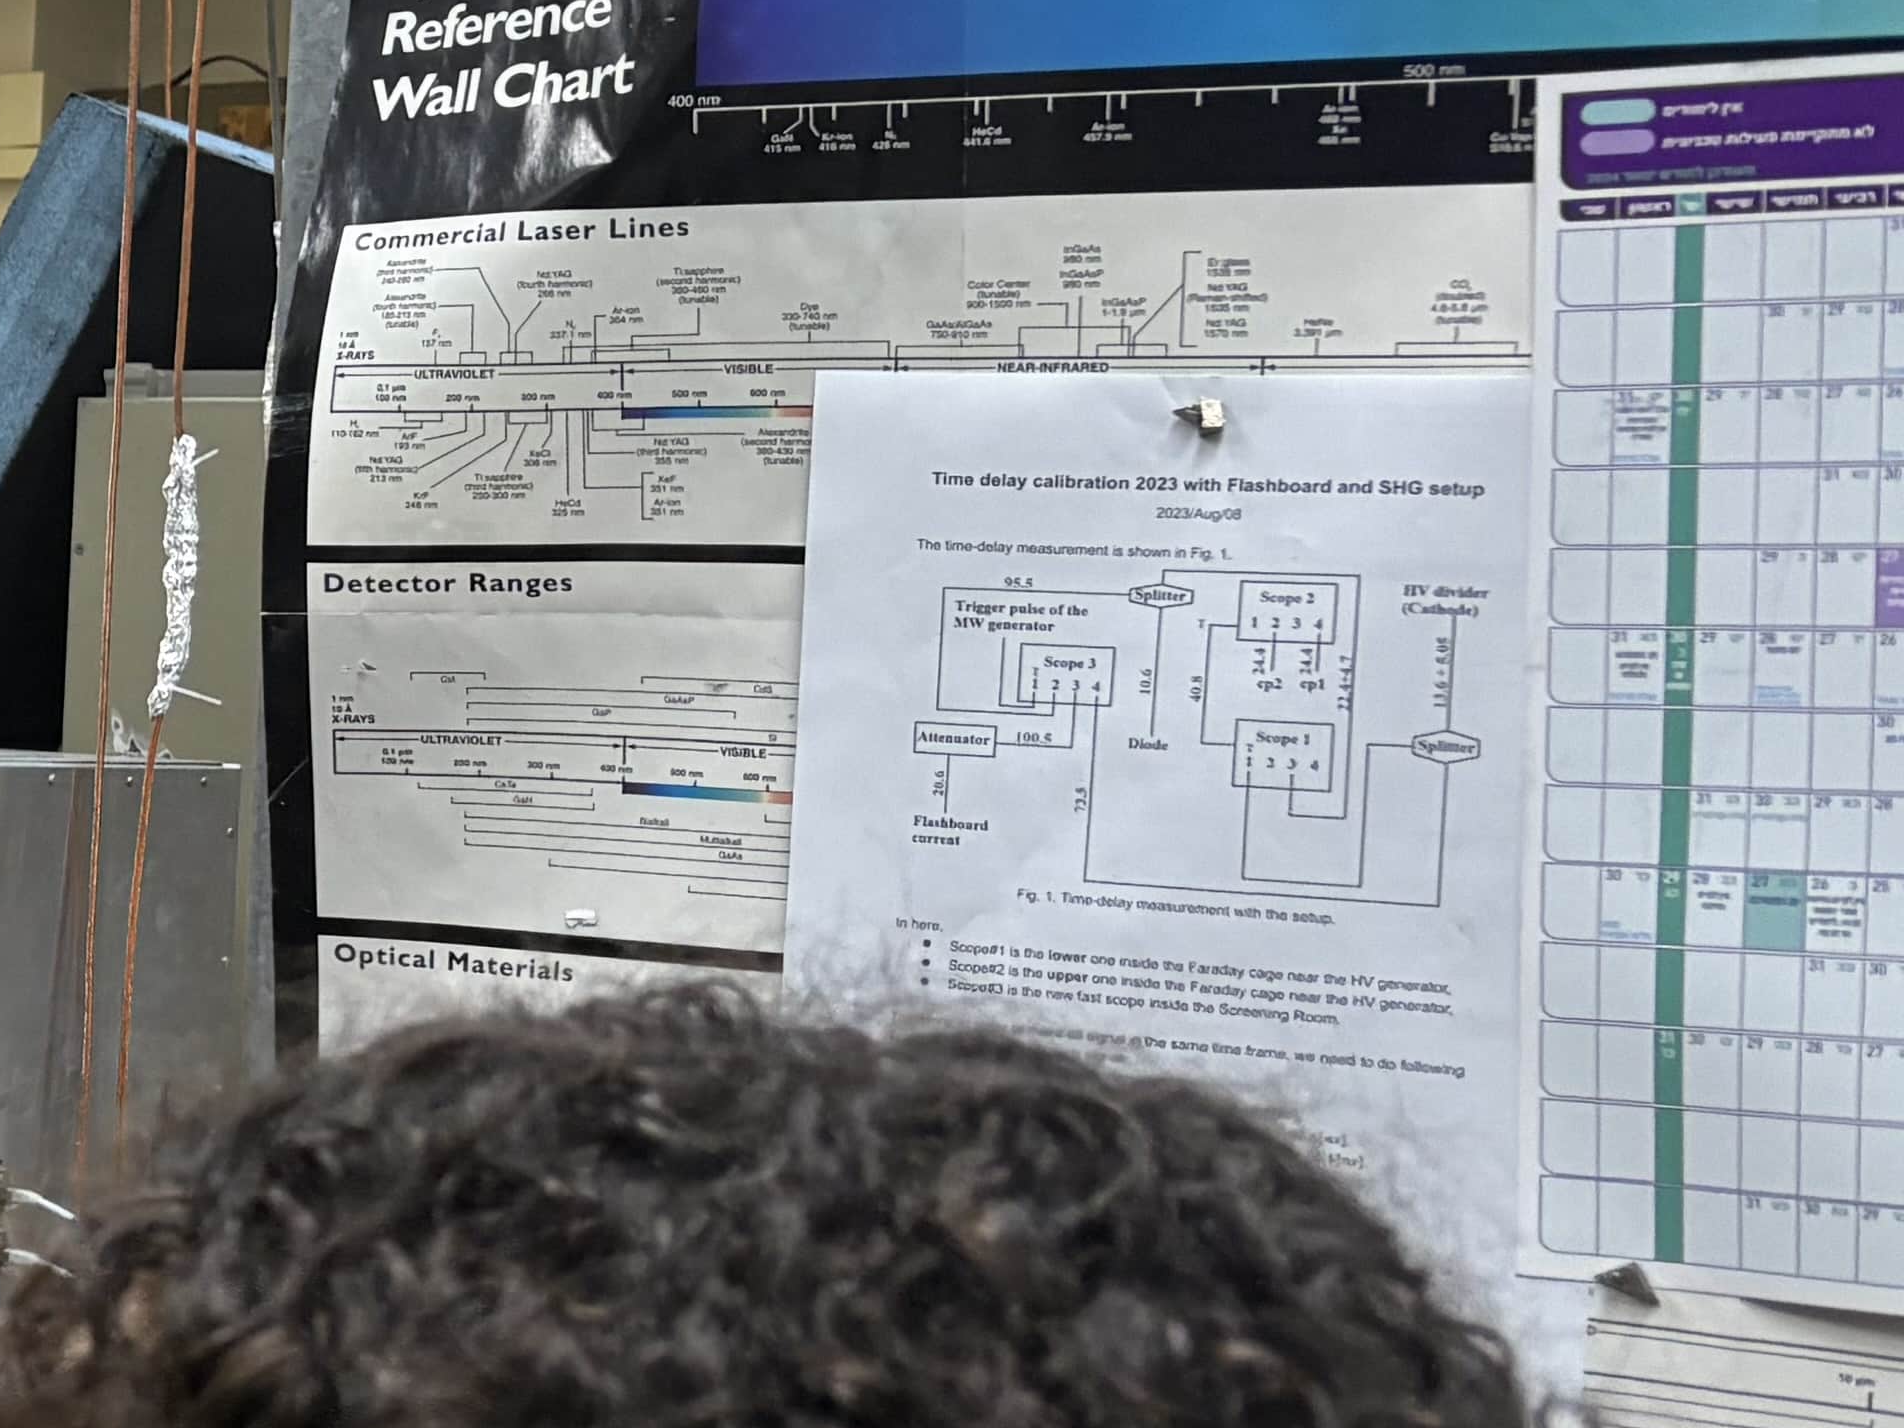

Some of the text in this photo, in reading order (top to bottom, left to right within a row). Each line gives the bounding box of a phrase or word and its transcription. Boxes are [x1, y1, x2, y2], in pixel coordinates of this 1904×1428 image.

[1403, 63, 1466, 78] 500 nm
[372, 53, 636, 122] Wall Chart
[667, 95, 722, 107] 400 nm
[355, 218, 690, 251] Commercial Laser Lines
[414, 369, 496, 380] ULTRAVIOLET
[723, 363, 774, 375] VISIBLE
[996, 362, 1110, 374] NEAR-INFRARED
[932, 471, 1485, 500] Time delay calibration 2023 with Flashboard and SHG setup
[1155, 506, 1242, 523] 2023/Aug/08
[917, 537, 942, 551] The
[945, 538, 1013, 556] time-delay
[1016, 542, 1109, 557] measurement
[1112, 545, 1124, 557] is
[1127, 546, 1172, 558] shown
[1174, 546, 1187, 558] in
[1190, 547, 1214, 563] Fig.
[323, 571, 574, 598] Detector Ranges
[1004, 576, 1034, 589] 95.5
[1133, 587, 1187, 604] Splitter
[1259, 590, 1316, 608] Scope 2
[1403, 583, 1490, 600] HV divider
[954, 599, 1089, 618] Trigger pulse of the
[953, 616, 1056, 633] MW generator
[1043, 656, 1097, 672] Scope 3
[1140, 668, 1152, 695] 10.6
[1189, 675, 1203, 703] 40.8
[1257, 678, 1284, 694] cp2
[1300, 678, 1326, 694] cp1
[331, 714, 376, 725] X-RAYS
[420, 735, 503, 747] ULTRAVIOLET
[917, 731, 991, 747] Attenuator
[1128, 737, 1169, 752] Diode
[1256, 731, 1300, 748] Scope
[719, 746, 768, 760] VISIBLE
[933, 770, 945, 797] 20.6
[913, 815, 990, 832] Flashboard
[911, 834, 961, 847] current
[1016, 887, 1041, 904] Fig.
[1060, 891, 1133, 912] Time-delay
[1136, 898, 1230, 918] measurement
[1233, 906, 1262, 920] with
[1265, 908, 1288, 922] the
[895, 917, 909, 930] In
[333, 943, 575, 984] Optical Materials
[1009, 946, 1020, 958] is
[1024, 947, 1044, 960] the
[1048, 949, 1087, 964] lower
[1090, 954, 1117, 967] one
[1119, 956, 1159, 971] inside
[1163, 959, 1185, 973] the
[1188, 960, 1246, 980] Faraday
[1248, 966, 1285, 983] cage
[1287, 969, 1320, 984] near
[1323, 971, 1347, 985] the
[1350, 973, 1375, 988] HV
[1008, 965, 1020, 977] is
[1023, 966, 1044, 980] the
[1047, 969, 1089, 985] upper
[1092, 973, 1118, 986] one
[1120, 976, 1162, 991] inside
[1164, 978, 1186, 993] the
[1190, 980, 1246, 1000] Faraday
[1250, 987, 1286, 1003] cage
[1288, 990, 1322, 1005] near
[1325, 992, 1348, 1007] the
[1352, 994, 1376, 1009] HV
[1007, 983, 1019, 996] is
[1022, 985, 1043, 999] the
[1076, 990, 1102, 1004] fast
[1105, 994, 1145, 1010] scope
[1149, 998, 1189, 1013] inside
[1192, 1000, 1215, 1015] the
[1217, 1003, 1290, 1023] Screening
[1144, 1036, 1167, 1049] the
[1170, 1038, 1209, 1054] same
[1211, 1041, 1242, 1056] time
[1294, 1050, 1316, 1062] we
